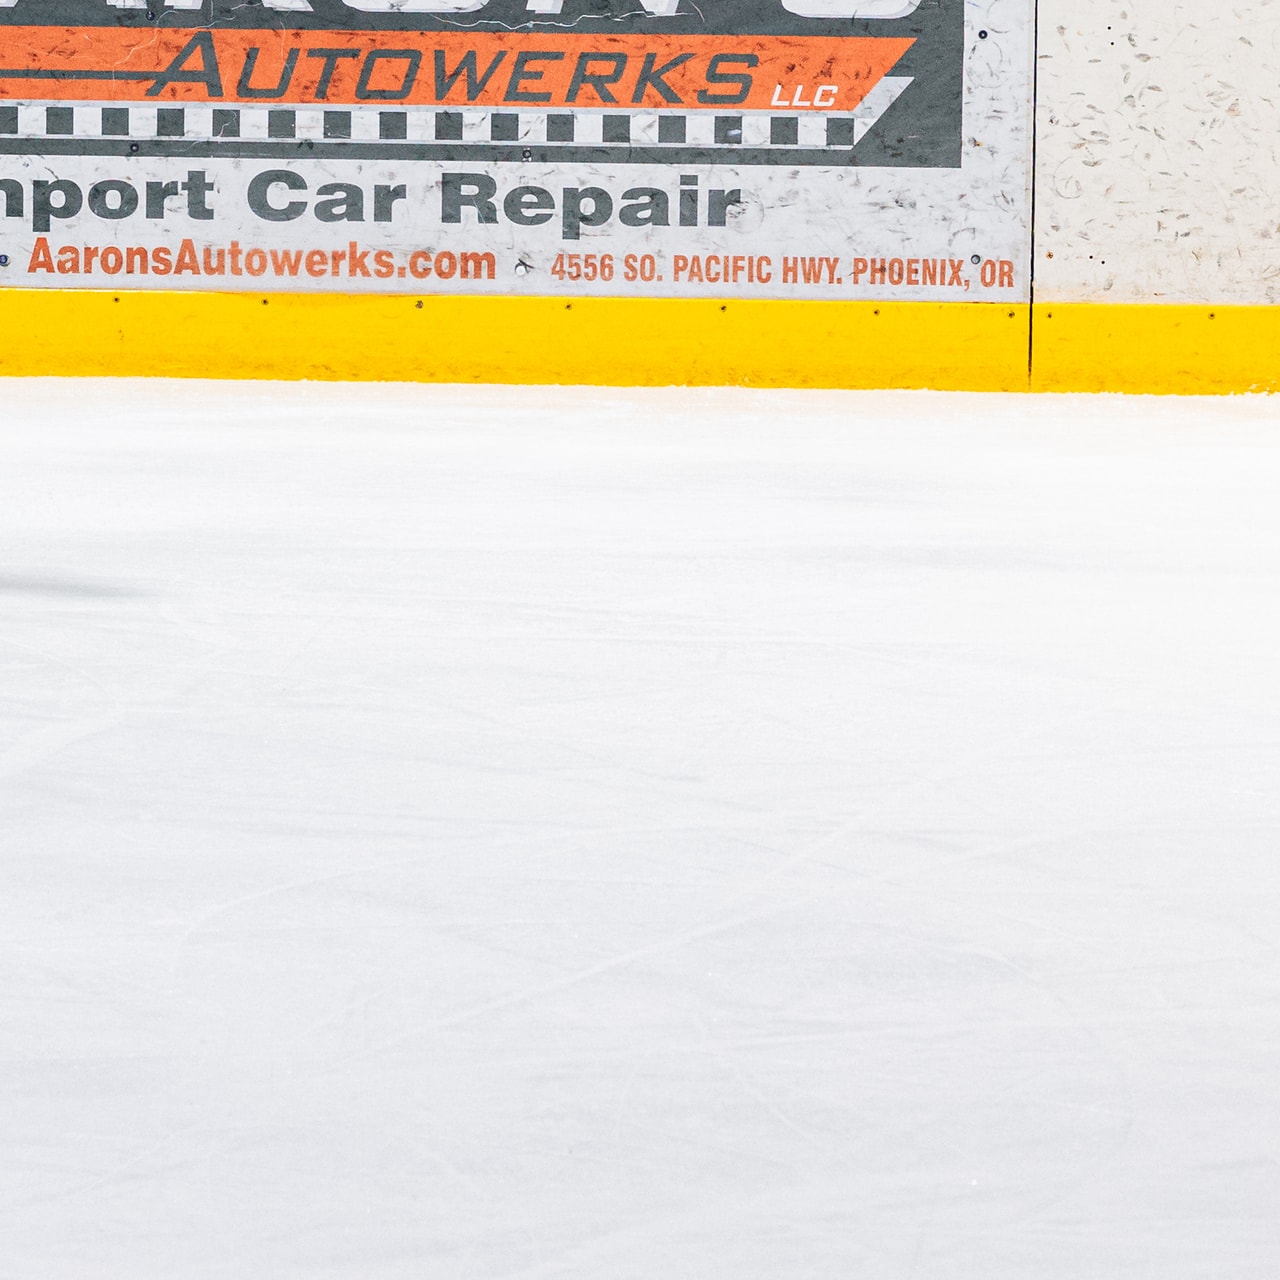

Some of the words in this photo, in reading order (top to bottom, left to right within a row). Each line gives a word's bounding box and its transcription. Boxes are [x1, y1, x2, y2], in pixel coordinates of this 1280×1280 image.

[146, 31, 760, 106] AUTOWERKS
[770, 84, 838, 108] LLC
[247, 169, 407, 224] Car
[440, 172, 744, 241] Repair
[27, 236, 497, 282] AaronsAutowerks.com
[551, 253, 614, 282] 4556
[623, 254, 663, 282] SO.
[673, 255, 772, 284] PACIFIC
[782, 257, 842, 285] HWY.
[853, 258, 970, 291] PHOENIX,
[980, 259, 1015, 289] OR
